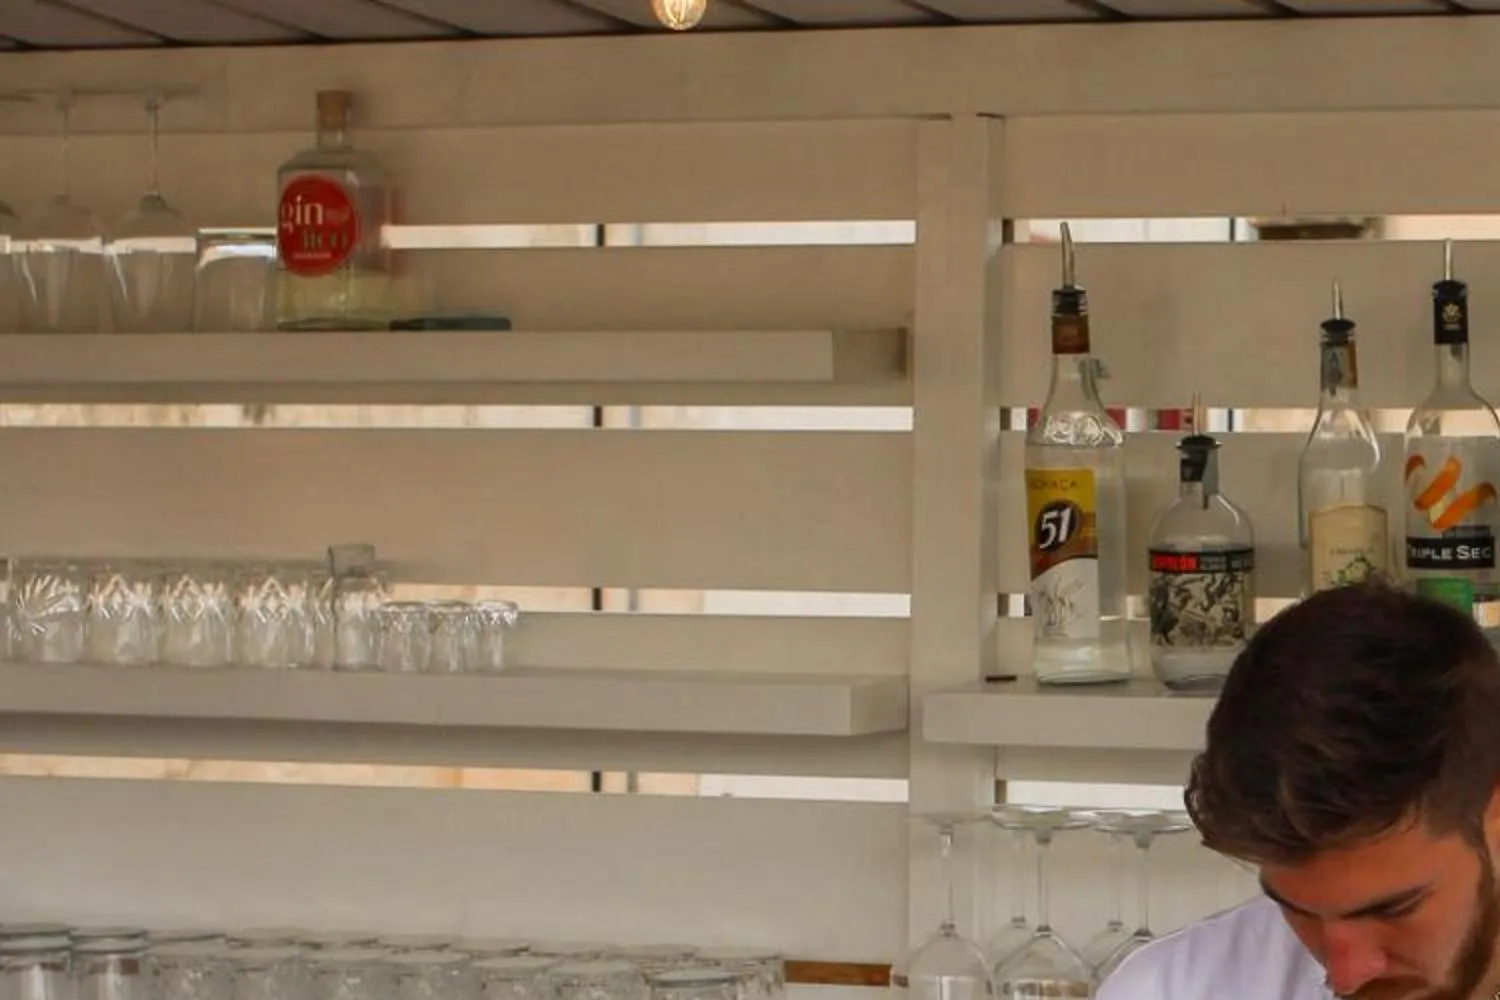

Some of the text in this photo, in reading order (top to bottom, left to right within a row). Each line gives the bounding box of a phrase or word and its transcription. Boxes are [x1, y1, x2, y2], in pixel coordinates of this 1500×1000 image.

[281, 195, 323, 235] gin
[1039, 507, 1072, 549] 51
[1408, 544, 1453, 560] IPLE
